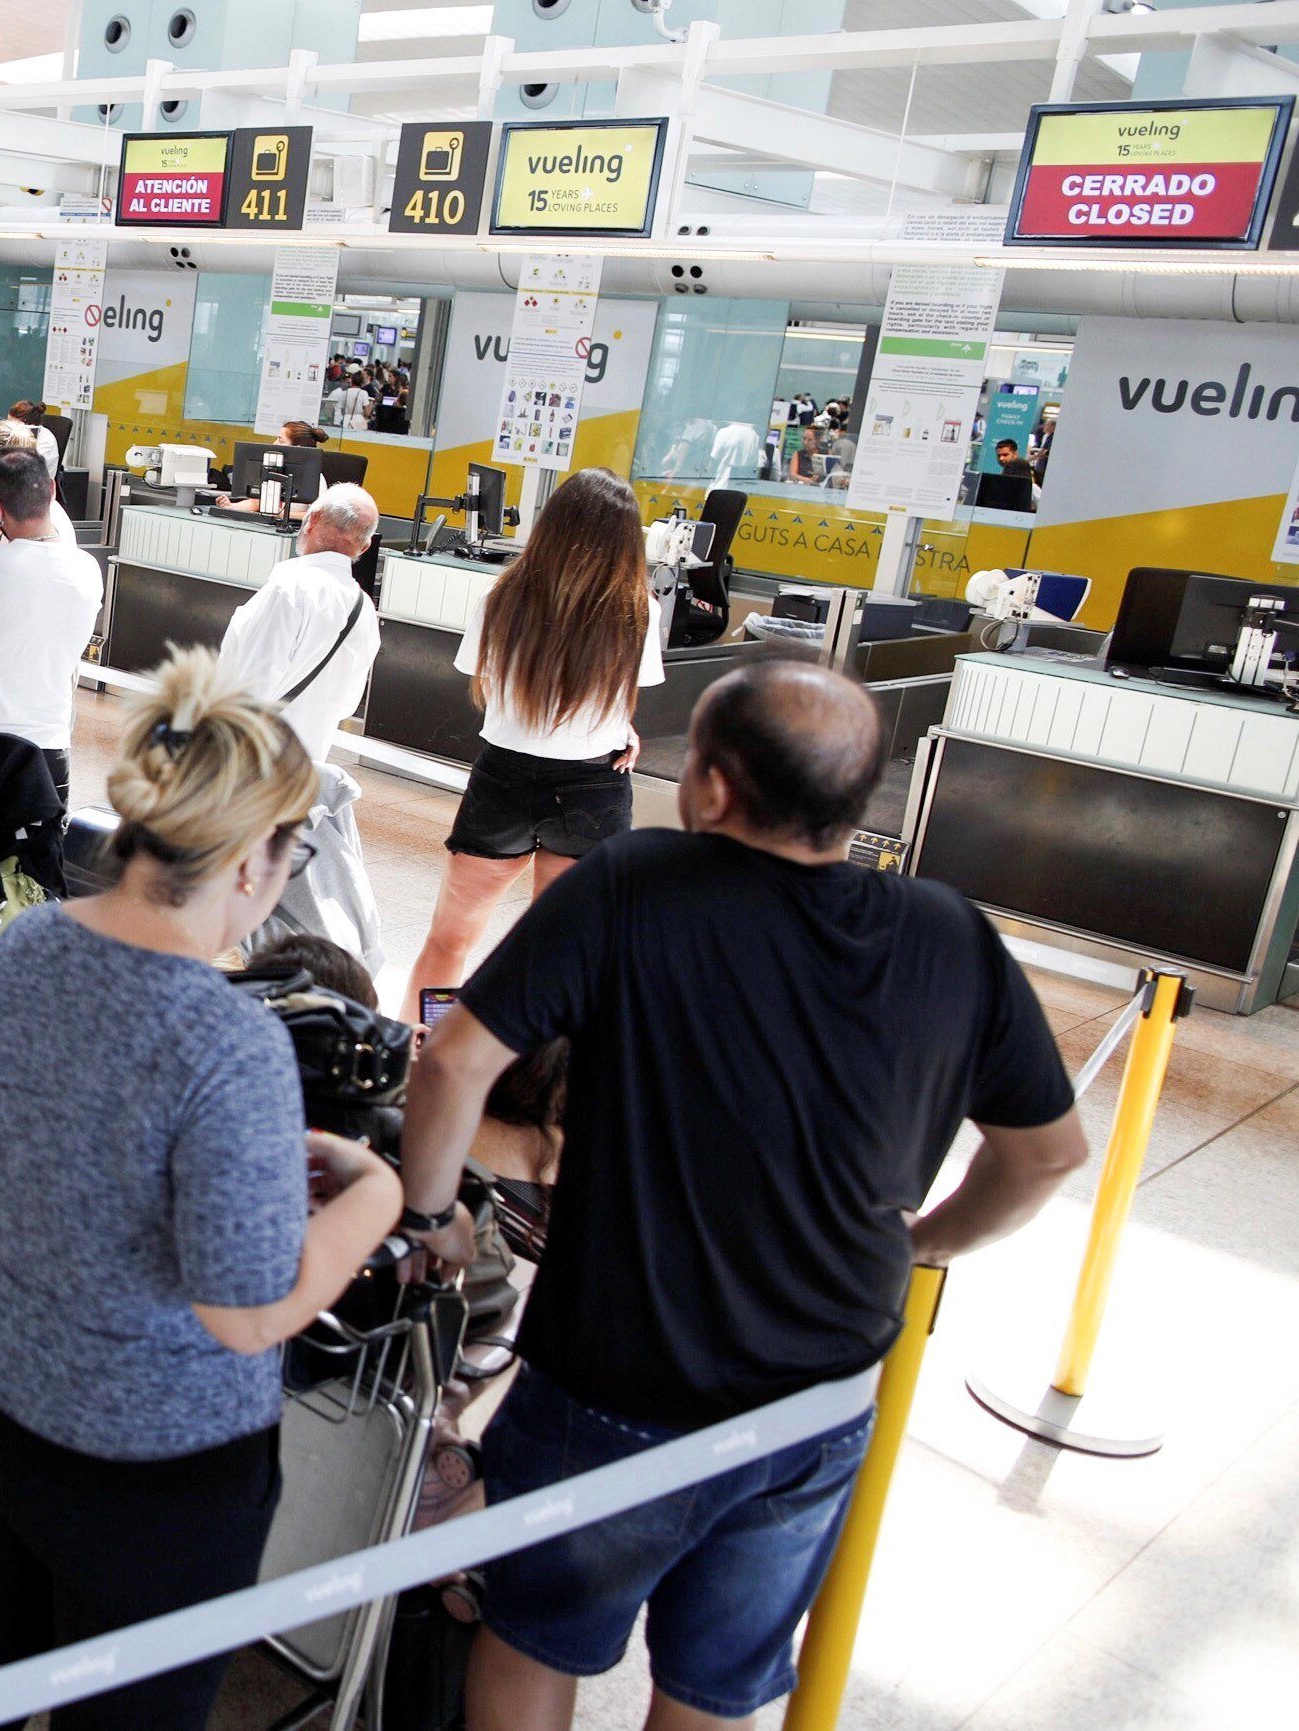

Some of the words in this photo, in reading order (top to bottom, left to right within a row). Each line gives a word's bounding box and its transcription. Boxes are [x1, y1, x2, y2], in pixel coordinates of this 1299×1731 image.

[1117, 120, 1181, 140] vueling
[161, 145, 188, 158] vueling
[1117, 144, 1131, 156] 15
[528, 144, 623, 183] vueling
[134, 176, 208, 194] ATENCIÓN
[551, 189, 579, 200] YEARS
[1061, 173, 1217, 197] CERRADO
[129, 198, 147, 212] AL
[150, 198, 211, 213] CLIENTE
[240, 189, 288, 221] 411
[403, 189, 465, 225] 410
[528, 189, 549, 212] 15
[584, 203, 618, 213] PLACES
[1067, 202, 1195, 226] CLOSED
[103, 294, 165, 343] eling
[1118, 362, 1299, 423] vuelin
[997, 401, 1028, 412] vueling
[738, 522, 789, 546] GUTS
[792, 531, 808, 549] A
[813, 534, 871, 559] CASA
